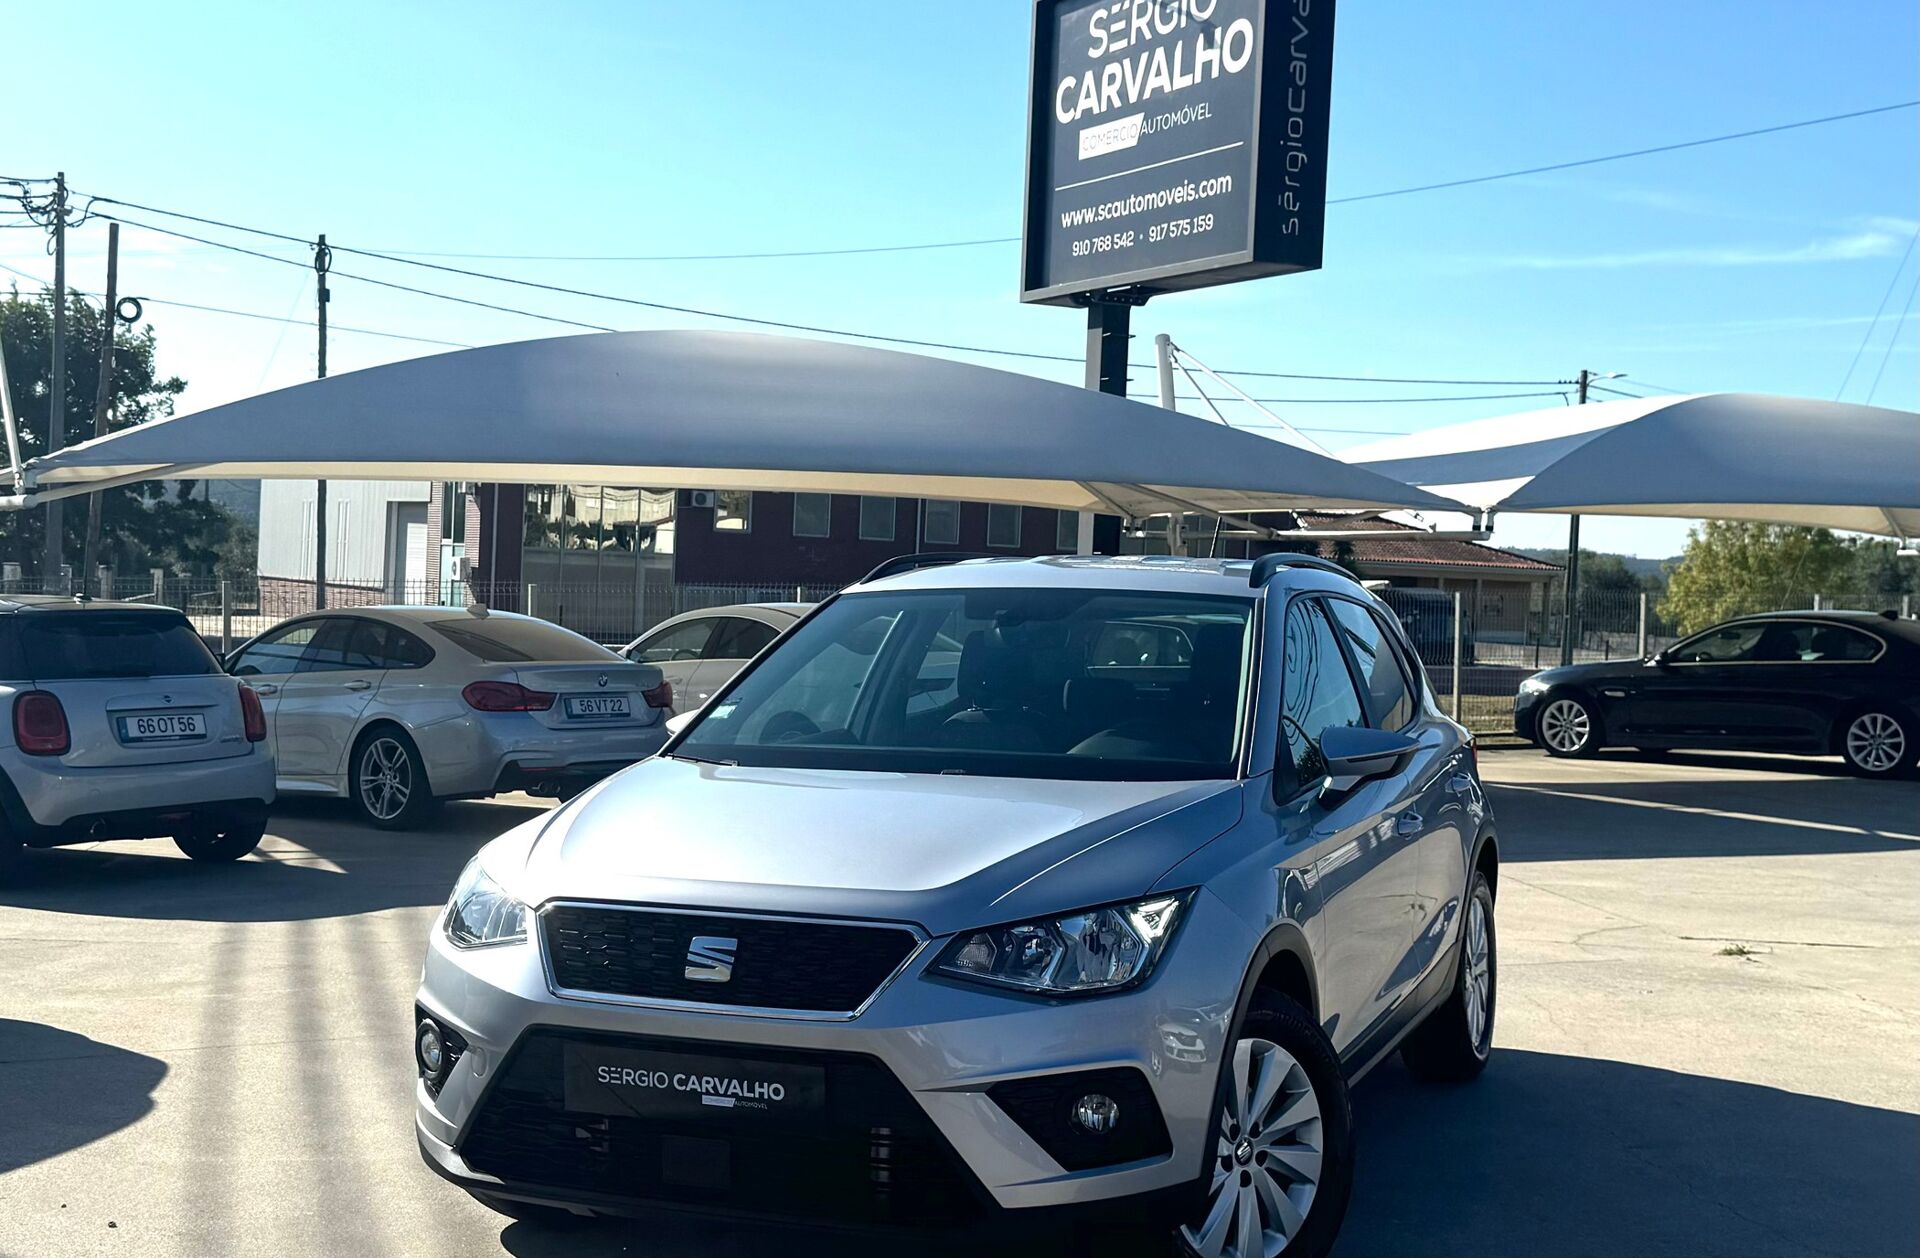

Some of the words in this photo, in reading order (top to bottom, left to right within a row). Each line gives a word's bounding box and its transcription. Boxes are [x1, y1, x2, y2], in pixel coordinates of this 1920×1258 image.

[1055, 18, 1254, 125] CARVALHO
[1140, 102, 1212, 136] AUTOMÓVEL
[1061, 174, 1232, 228] www.scautomoveis.com
[1072, 240, 1091, 256] 910
[1092, 235, 1112, 252] 768
[1113, 230, 1135, 249] 542
[1149, 223, 1168, 242] 917
[1169, 218, 1191, 237] 575
[1193, 213, 1214, 233] 159
[672, 1073, 785, 1101] CARVALHO
